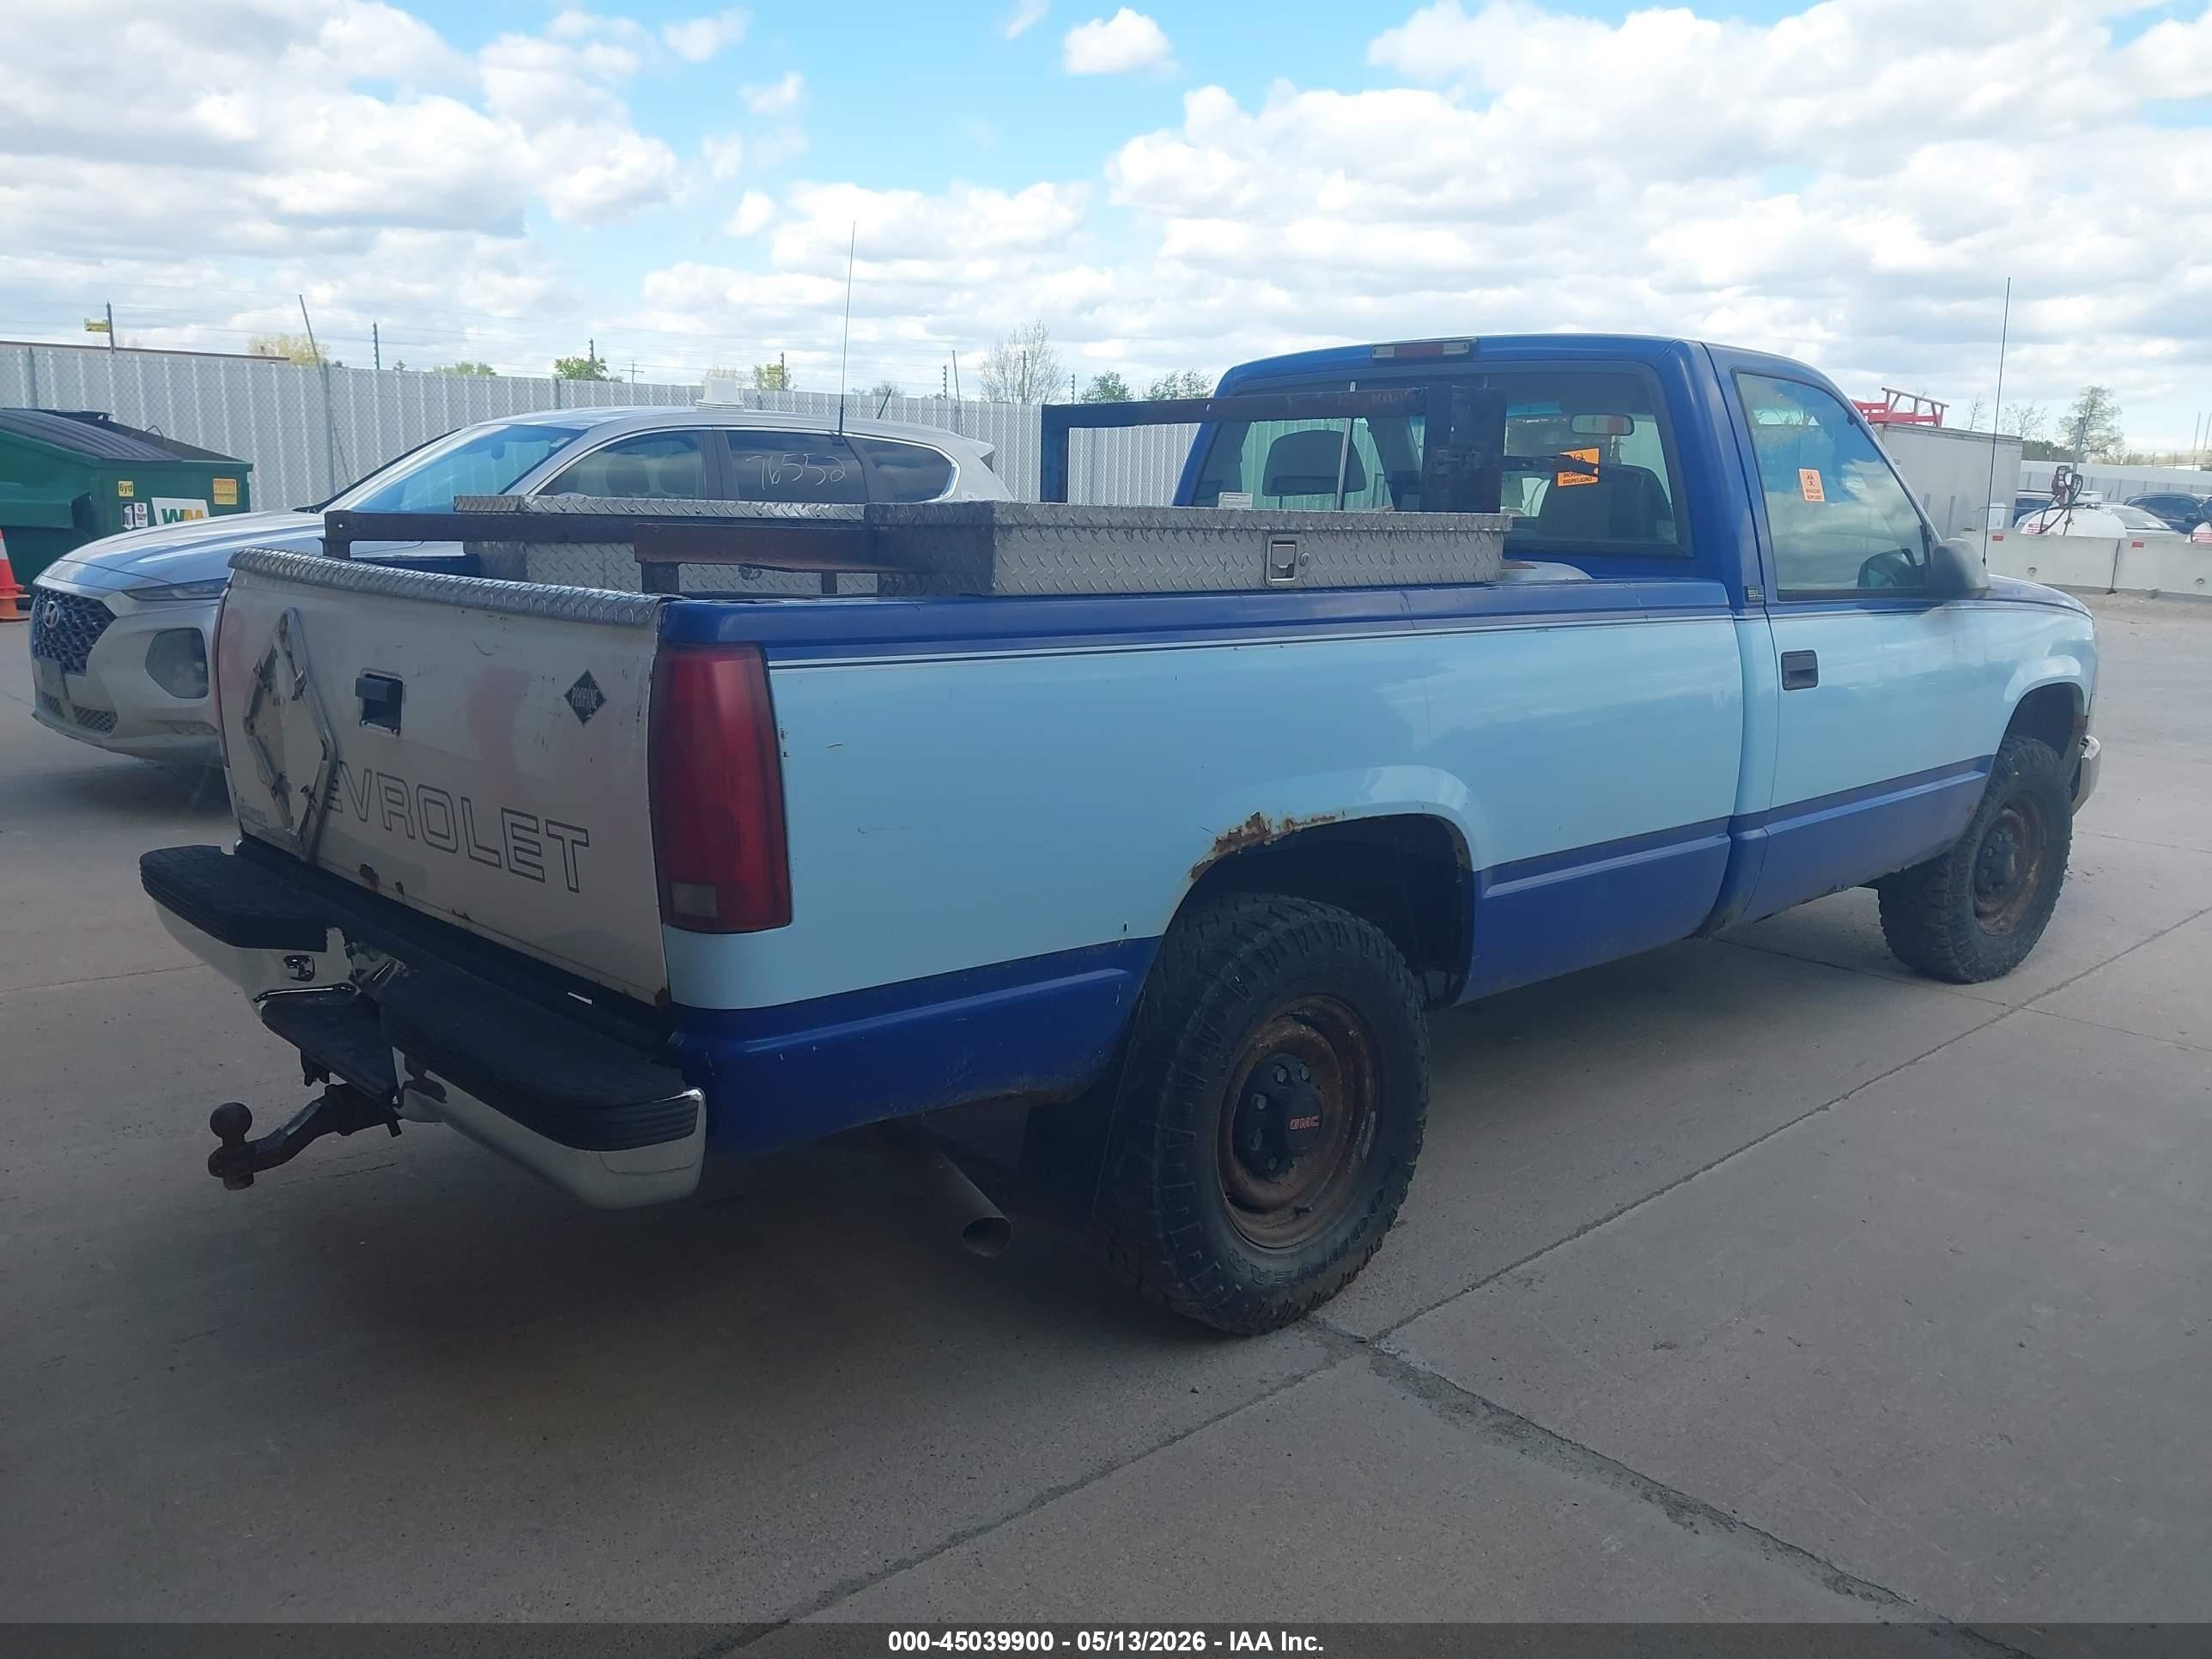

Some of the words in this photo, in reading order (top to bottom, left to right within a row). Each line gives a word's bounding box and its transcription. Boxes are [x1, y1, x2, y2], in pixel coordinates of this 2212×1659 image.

[745, 453, 847, 490] 76552
[118, 483, 133, 494] 6yd
[1290, 1115, 1320, 1130] GMC
